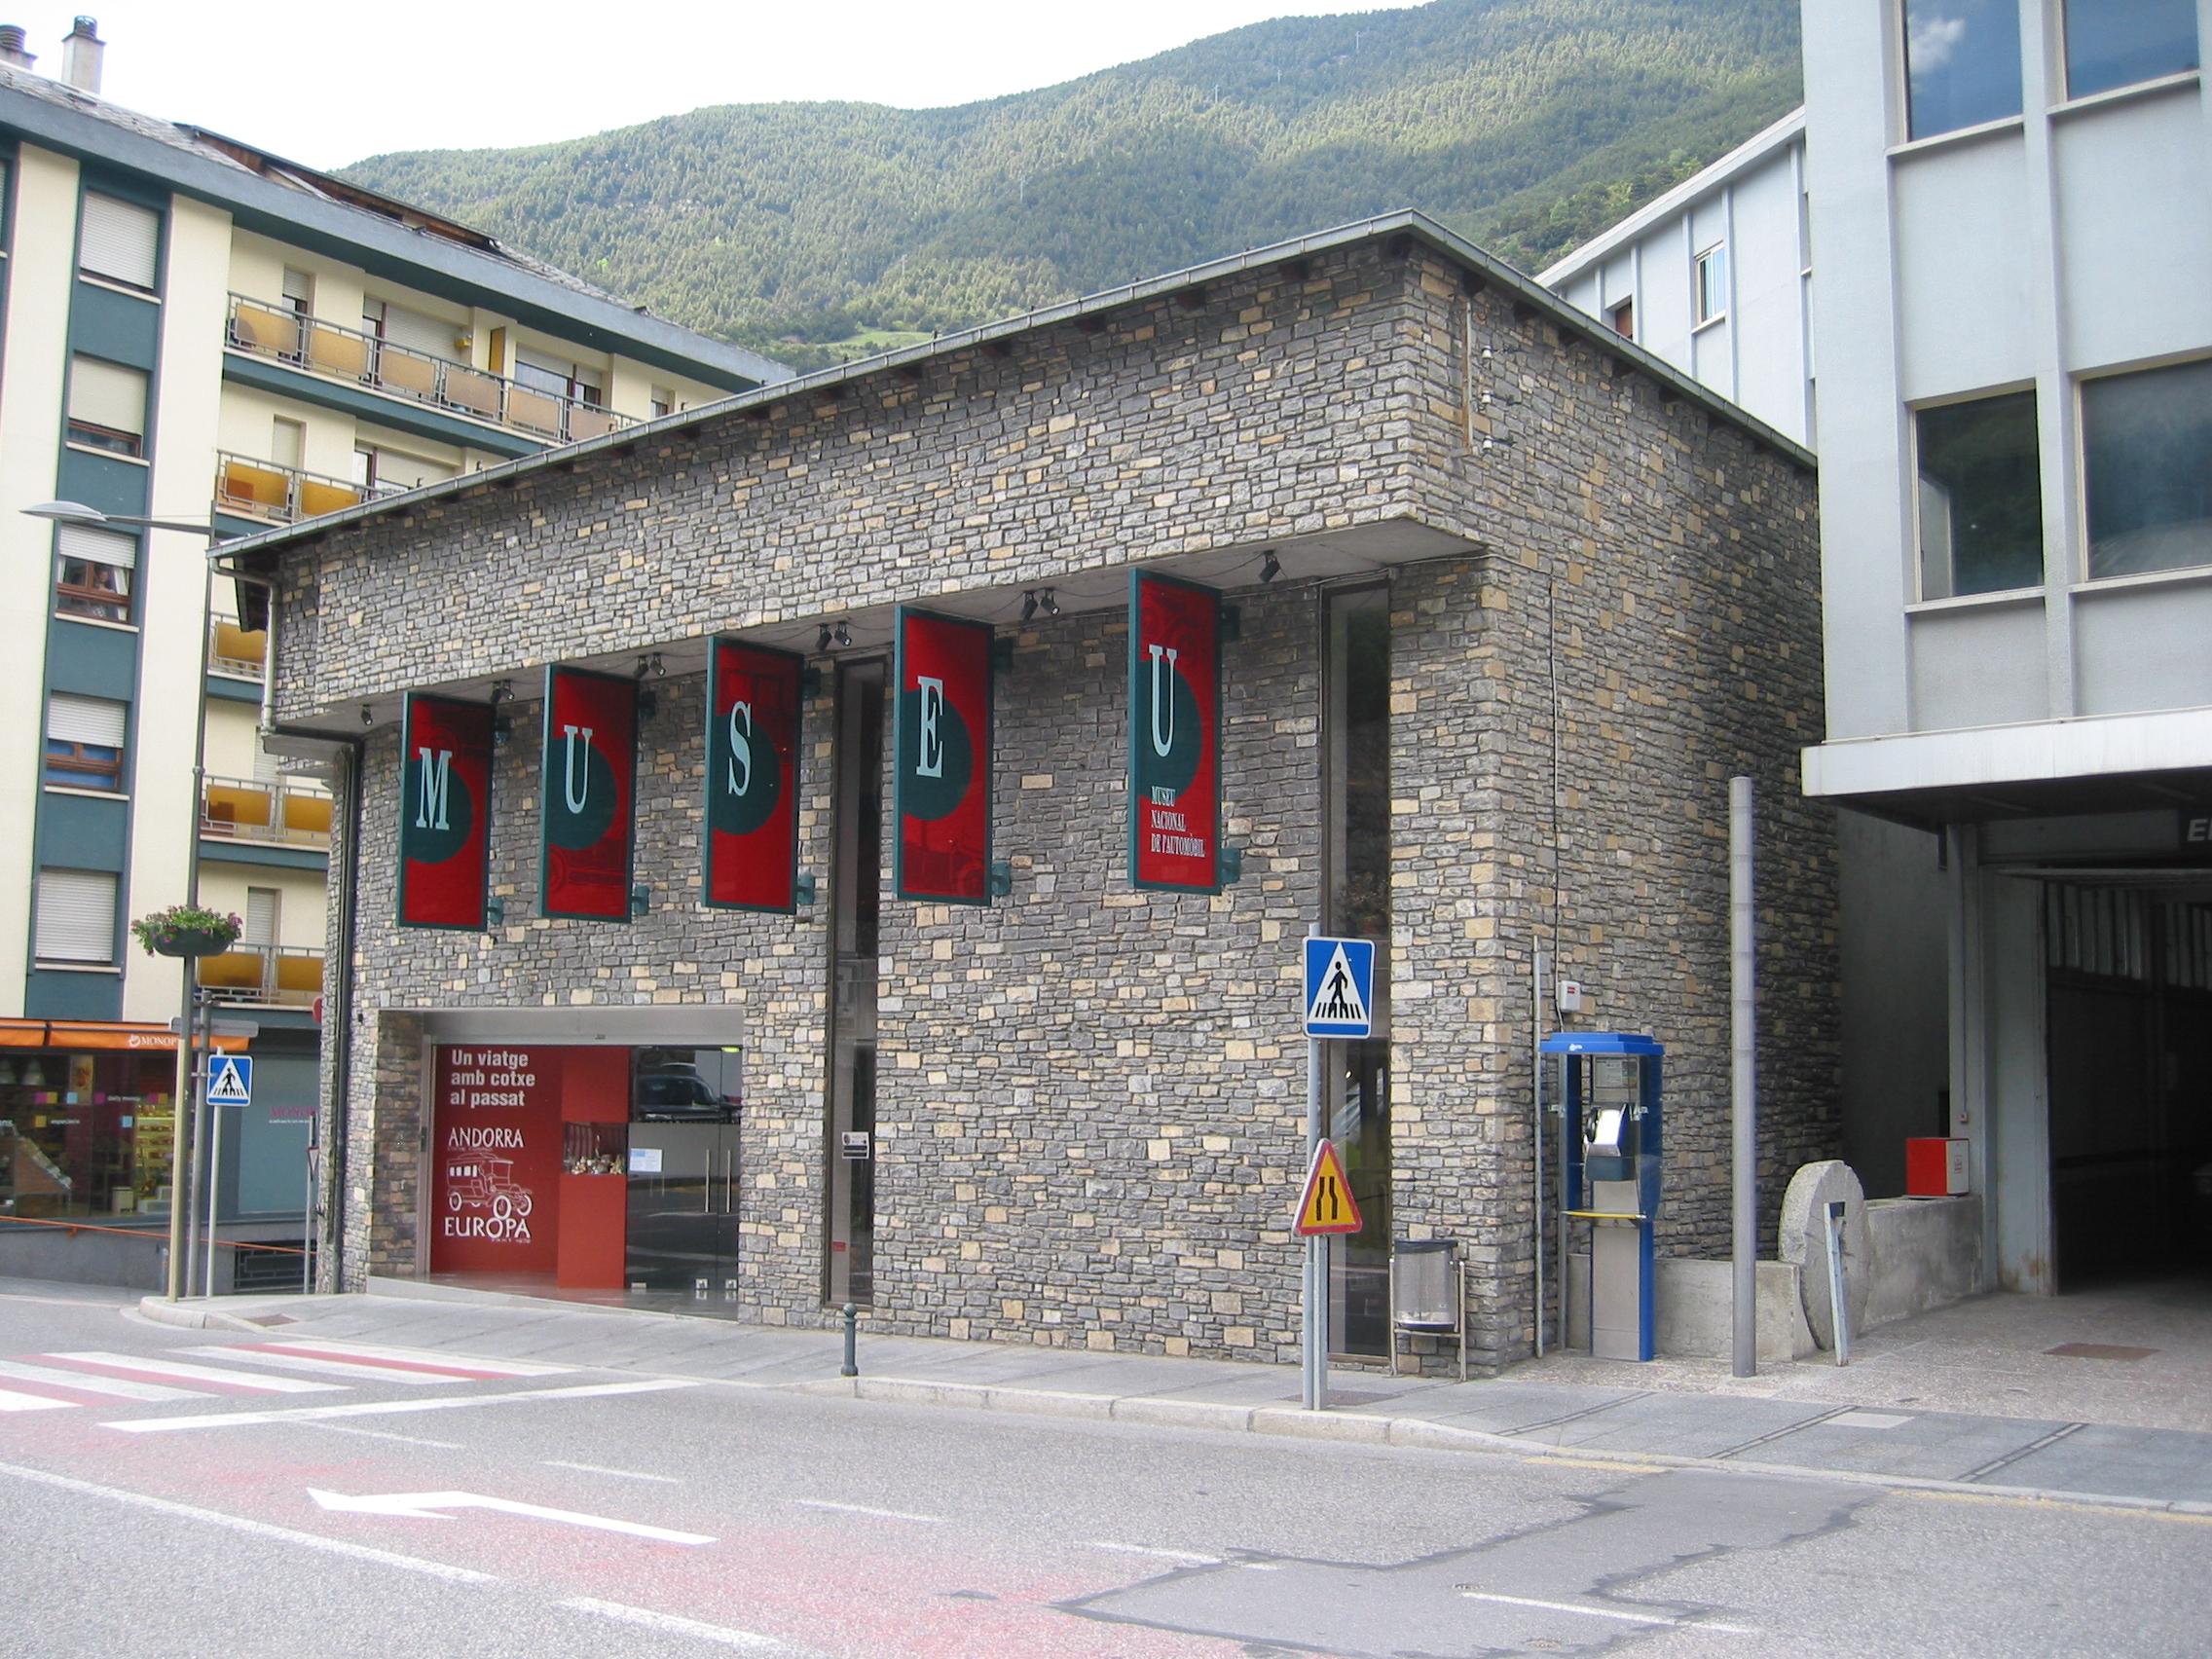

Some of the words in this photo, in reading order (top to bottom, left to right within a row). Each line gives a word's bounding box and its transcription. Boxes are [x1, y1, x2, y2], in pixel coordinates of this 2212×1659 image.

[416, 747, 453, 830] M
[563, 724, 593, 815] U
[728, 700, 753, 797] S
[915, 675, 944, 779] E
[1148, 644, 1177, 758] U
[1151, 785, 1176, 807] MUSEU
[1151, 809, 1186, 831] NACIONAL
[452, 1049, 473, 1066] Un
[477, 1050, 529, 1070] viatge
[451, 1069, 485, 1087] amb
[490, 1070, 535, 1087] cotxe
[450, 1088, 466, 1105] al
[470, 1089, 526, 1109] passat
[448, 1126, 524, 1147] ANDORRA
[444, 1216, 532, 1239] EUROPA
